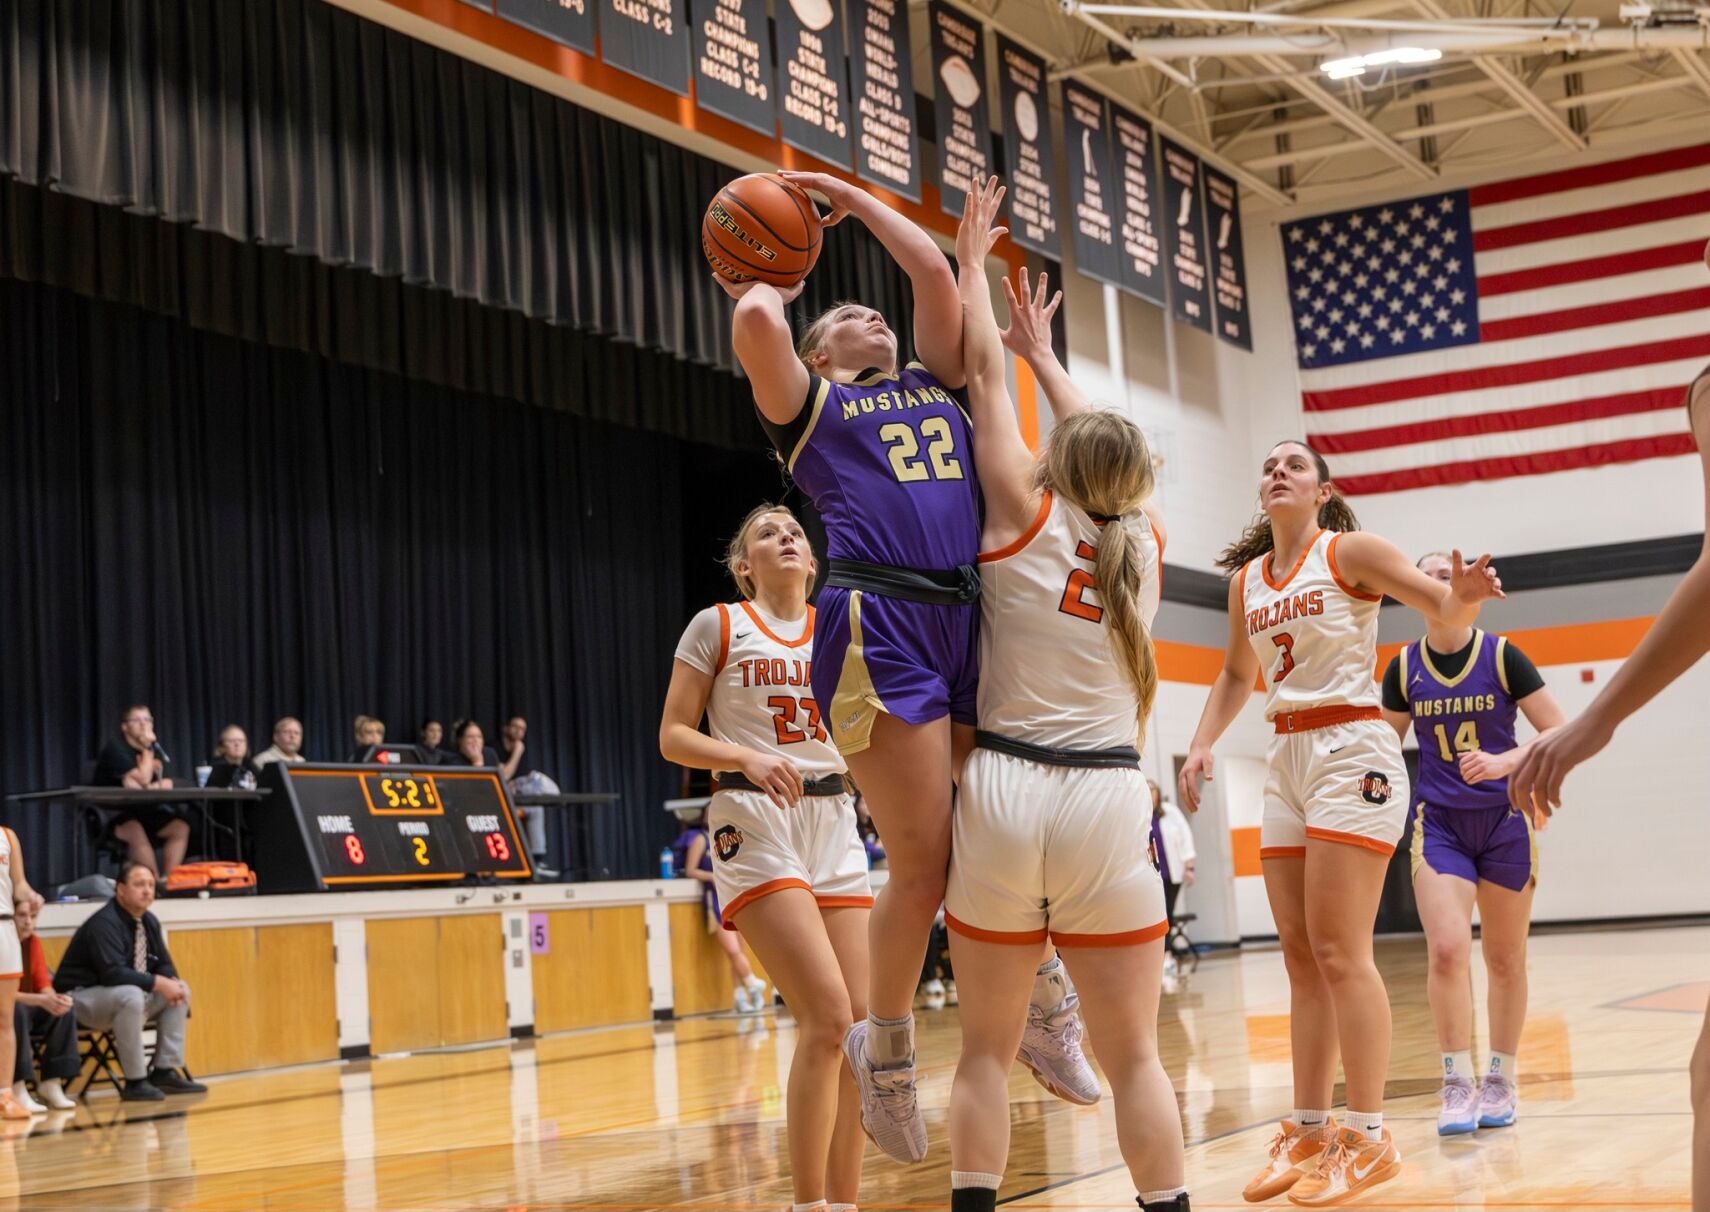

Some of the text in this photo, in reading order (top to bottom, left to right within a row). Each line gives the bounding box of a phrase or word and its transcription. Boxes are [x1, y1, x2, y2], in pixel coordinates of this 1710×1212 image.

[653, 12, 673, 35] C-2
[706, 40, 739, 69] CLASS
[700, 56, 742, 89] RECORD
[724, 218, 777, 263] ELITE
[879, 416, 966, 483] 22
[1271, 632, 1295, 683] 3
[1414, 693, 1496, 718] MUSTANGS
[1434, 720, 1482, 762] 14
[381, 778, 434, 808] 5:21
[317, 814, 355, 834] HOME
[466, 814, 500, 832] GUEST
[345, 834, 365, 865] 8
[412, 837, 430, 866] 2
[484, 833, 510, 861] 13
[535, 925, 545, 948] 5
